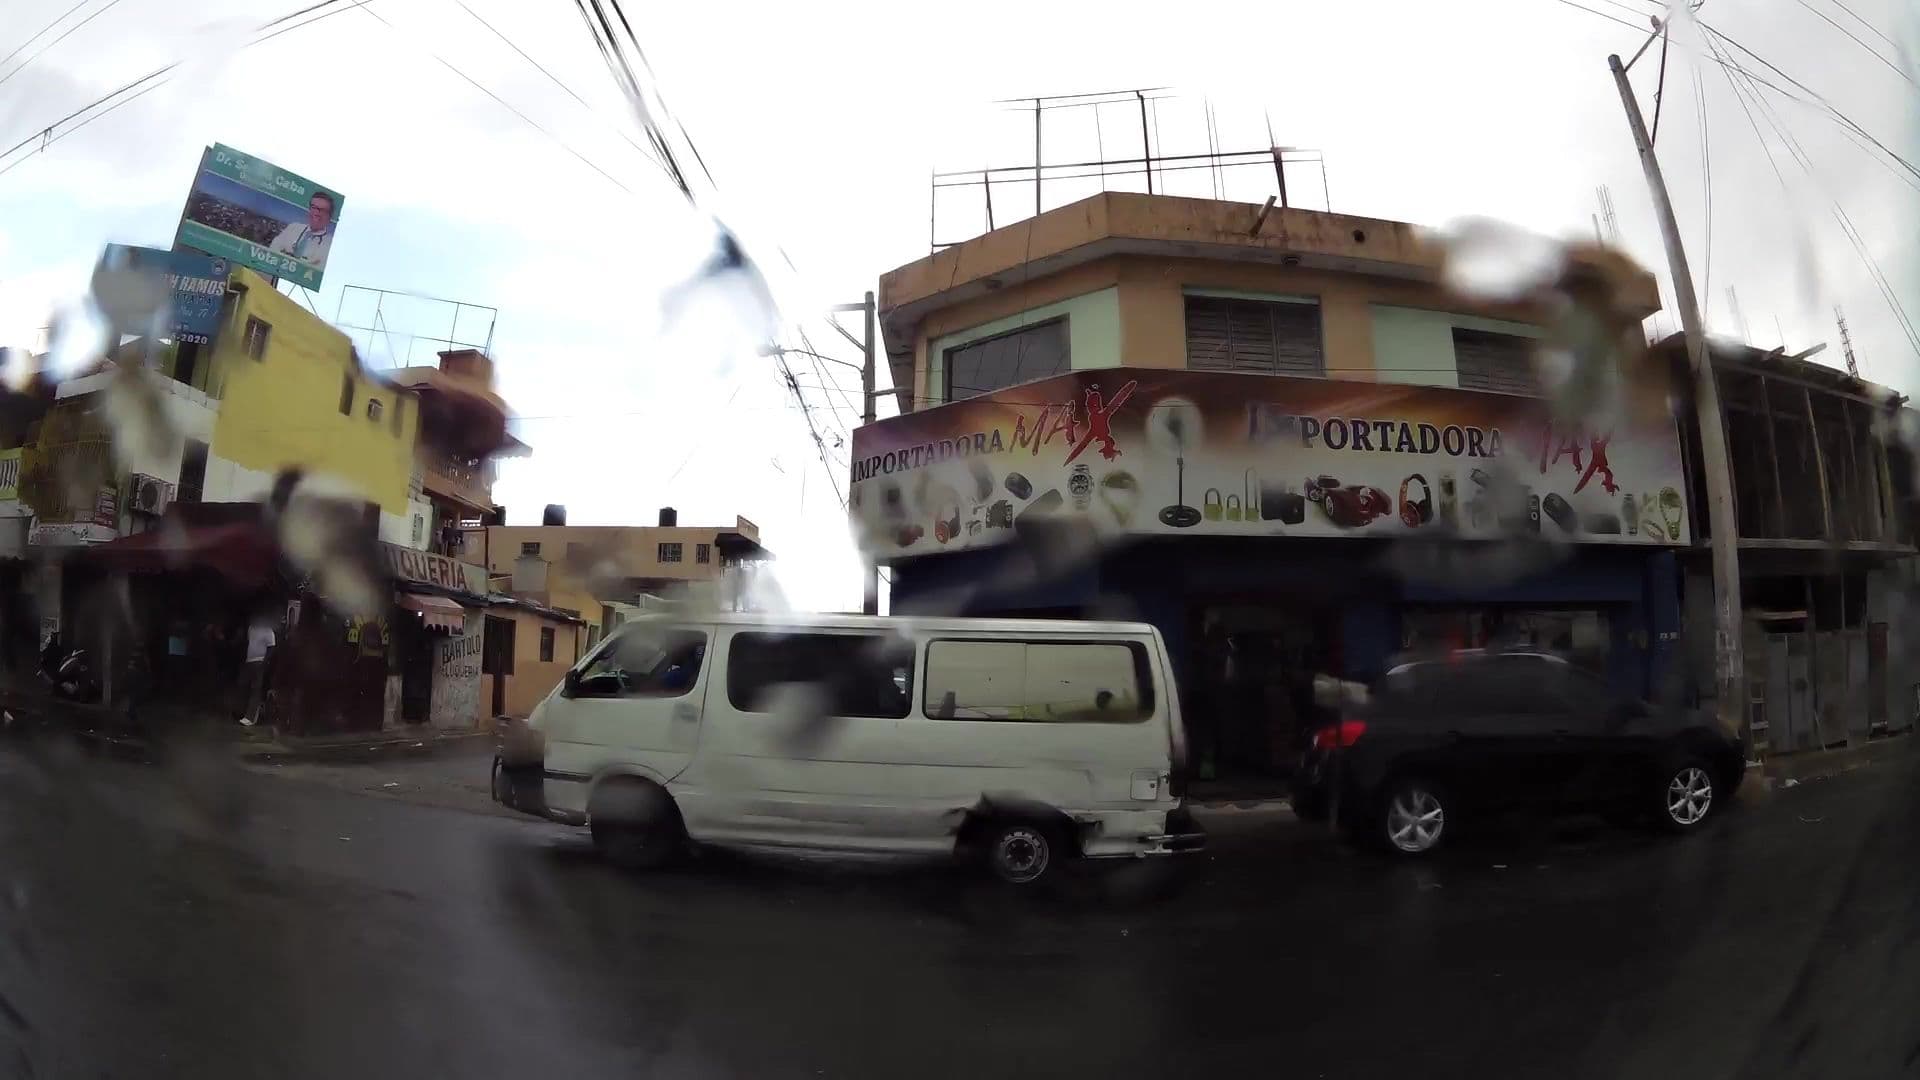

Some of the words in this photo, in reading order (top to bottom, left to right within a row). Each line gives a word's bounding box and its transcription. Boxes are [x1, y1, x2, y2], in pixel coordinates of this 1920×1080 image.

[216, 151, 232, 167] Dr.
[276, 175, 305, 196] Caba
[250, 245, 278, 266] Vota
[281, 258, 297, 273] 26
[179, 276, 226, 296] RAMOS
[851, 429, 1005, 483] IMPORTADORA
[1010, 380, 1137, 467] MAX
